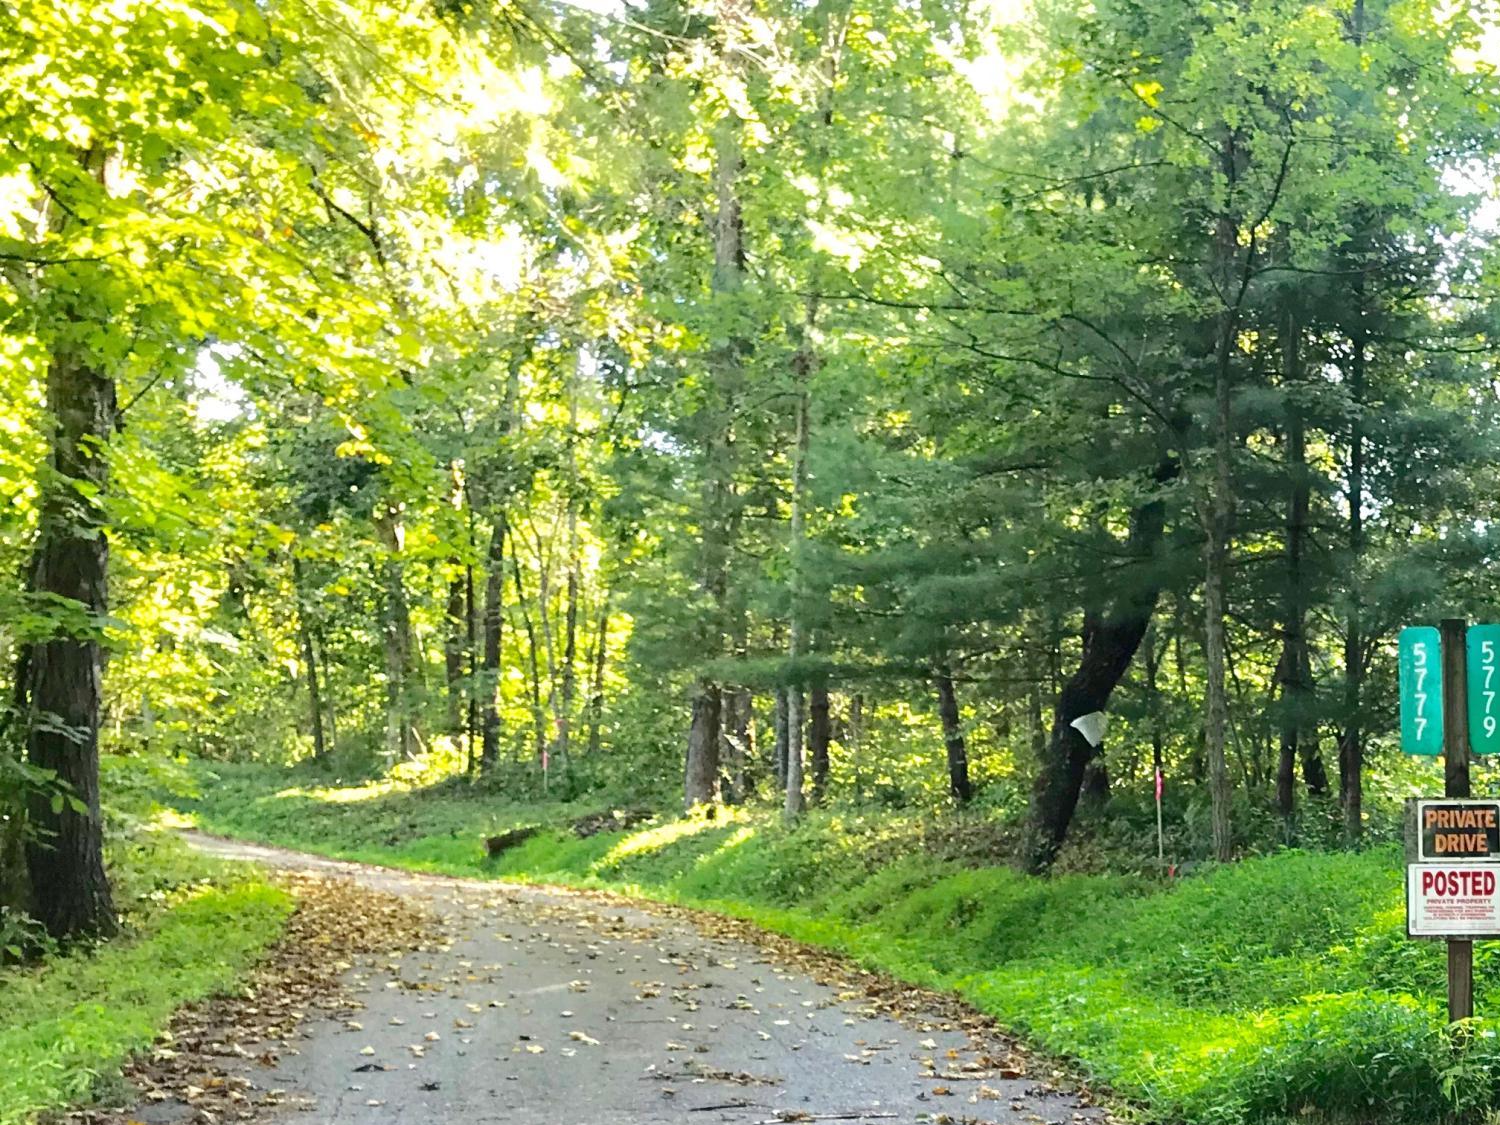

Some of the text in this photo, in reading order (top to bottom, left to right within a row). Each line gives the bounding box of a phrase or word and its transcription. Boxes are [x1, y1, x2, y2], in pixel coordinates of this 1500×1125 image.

[1412, 642, 1428, 741] 5777
[1481, 640, 1497, 738] 5779
[1425, 809, 1497, 829] PRIVATE
[1434, 833, 1489, 853] DRIVE
[1422, 870, 1496, 897] POSTED
